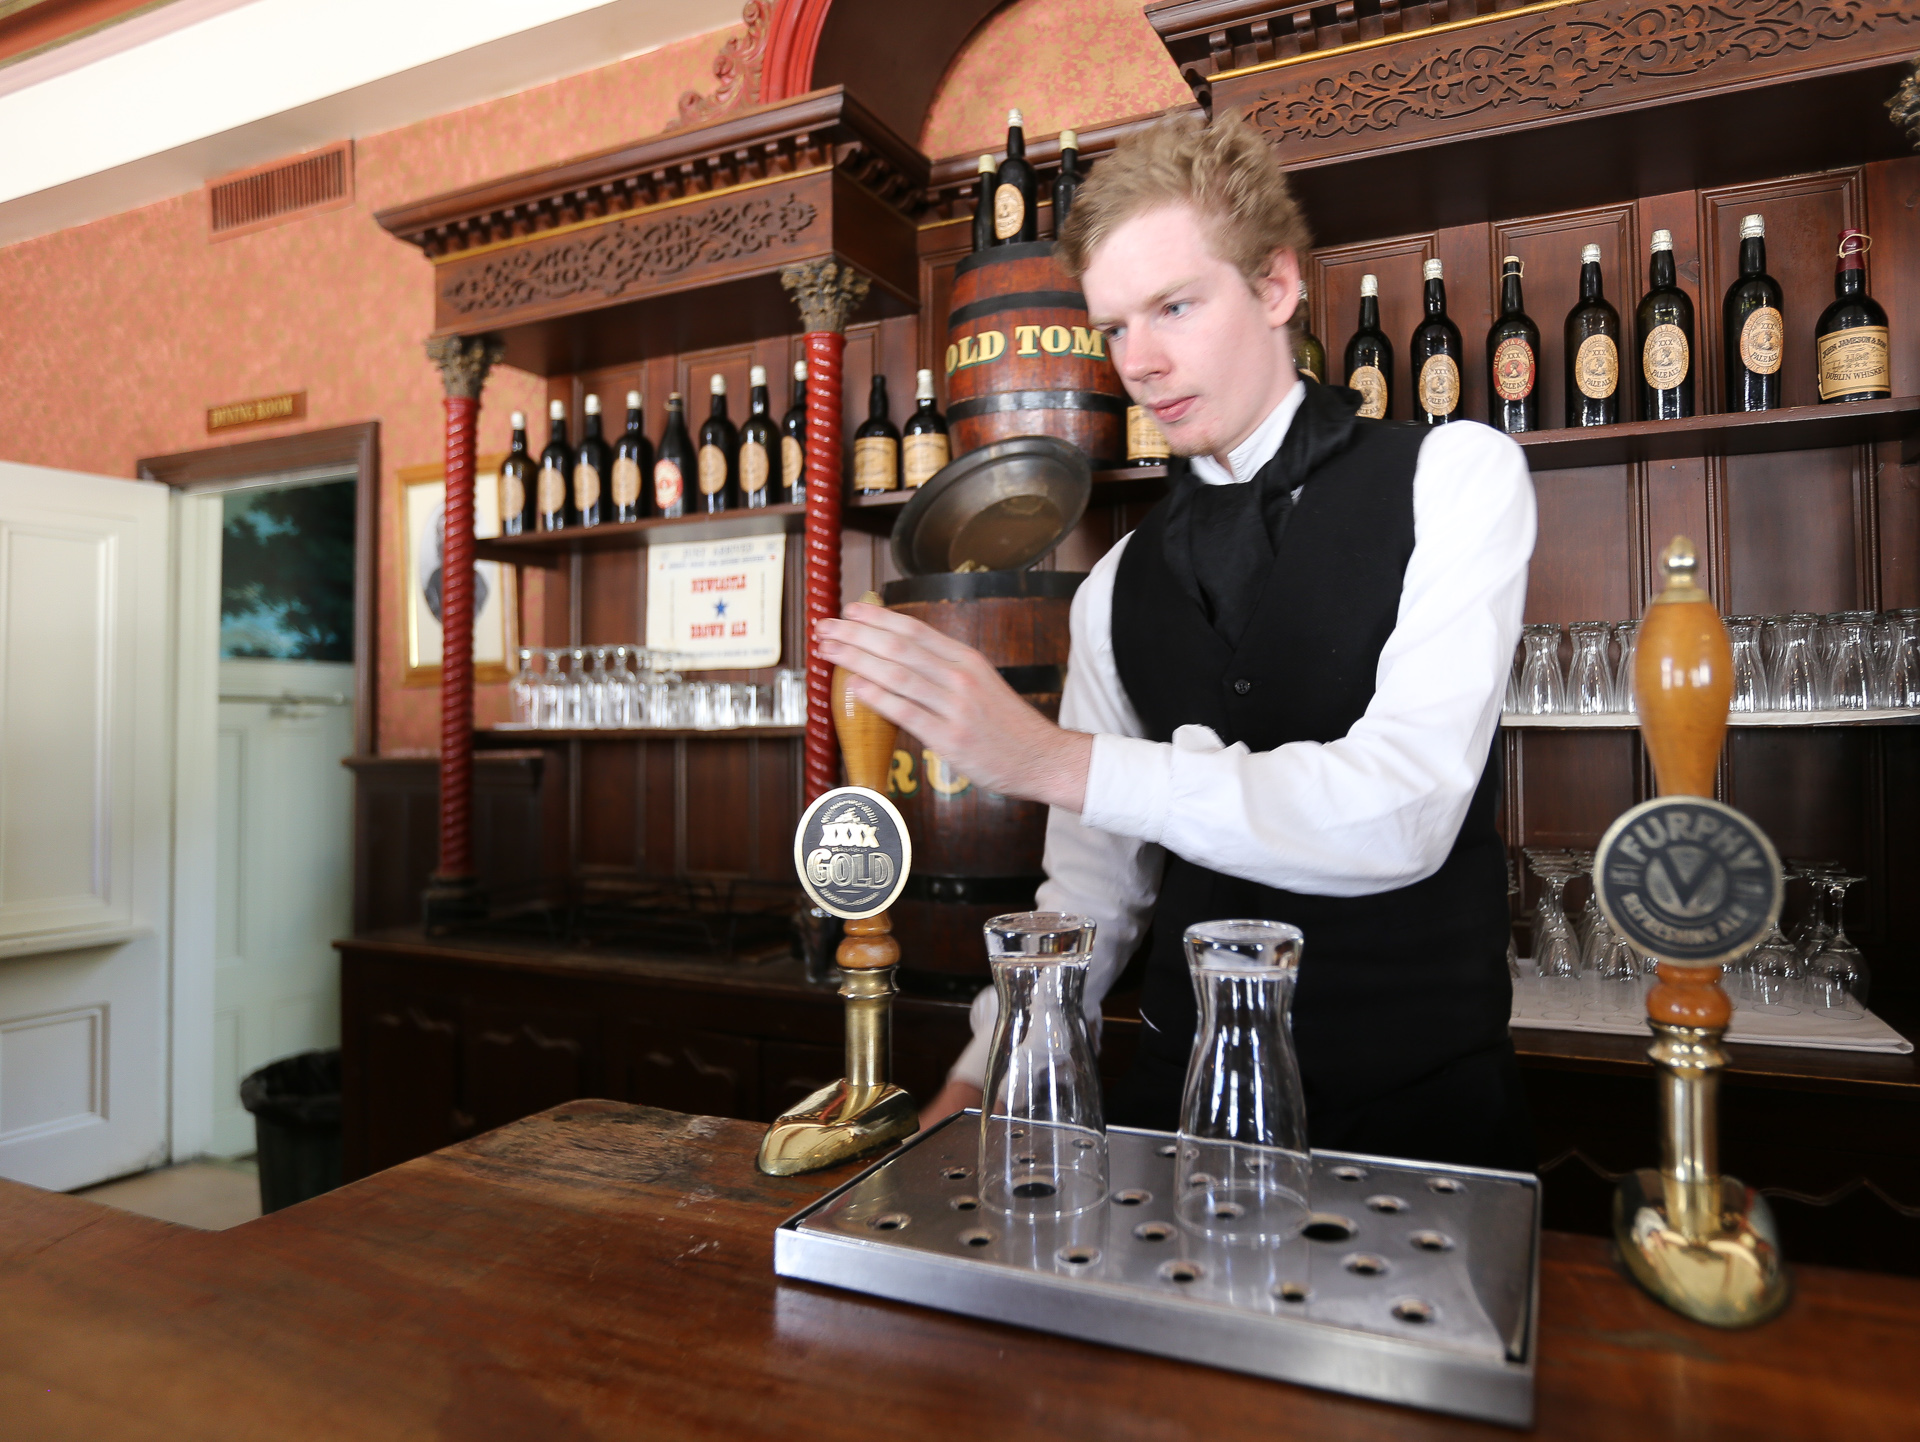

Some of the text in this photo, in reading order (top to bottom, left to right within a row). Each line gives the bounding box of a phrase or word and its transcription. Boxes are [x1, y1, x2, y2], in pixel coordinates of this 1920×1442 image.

[945, 325, 1107, 375] OLD TOM
[1838, 336, 1871, 348] JAMESON
[1493, 338, 1516, 369] VICTORIA
[1517, 339, 1535, 365] PARADE
[1751, 351, 1779, 362] PALE ALE
[1651, 366, 1681, 379] PALE ALE
[1826, 371, 1851, 381] DUBLIN
[1501, 379, 1528, 389] PALE ALE
[1585, 377, 1613, 388] PALE ALE
[1496, 383, 1532, 400] BREWERY
[691, 574, 748, 594] NEWCASTLE
[691, 622, 725, 640] BROWN
[819, 823, 880, 849] XXXX
[1617, 811, 1766, 872] FURPHY
[806, 848, 895, 890] GOLD
